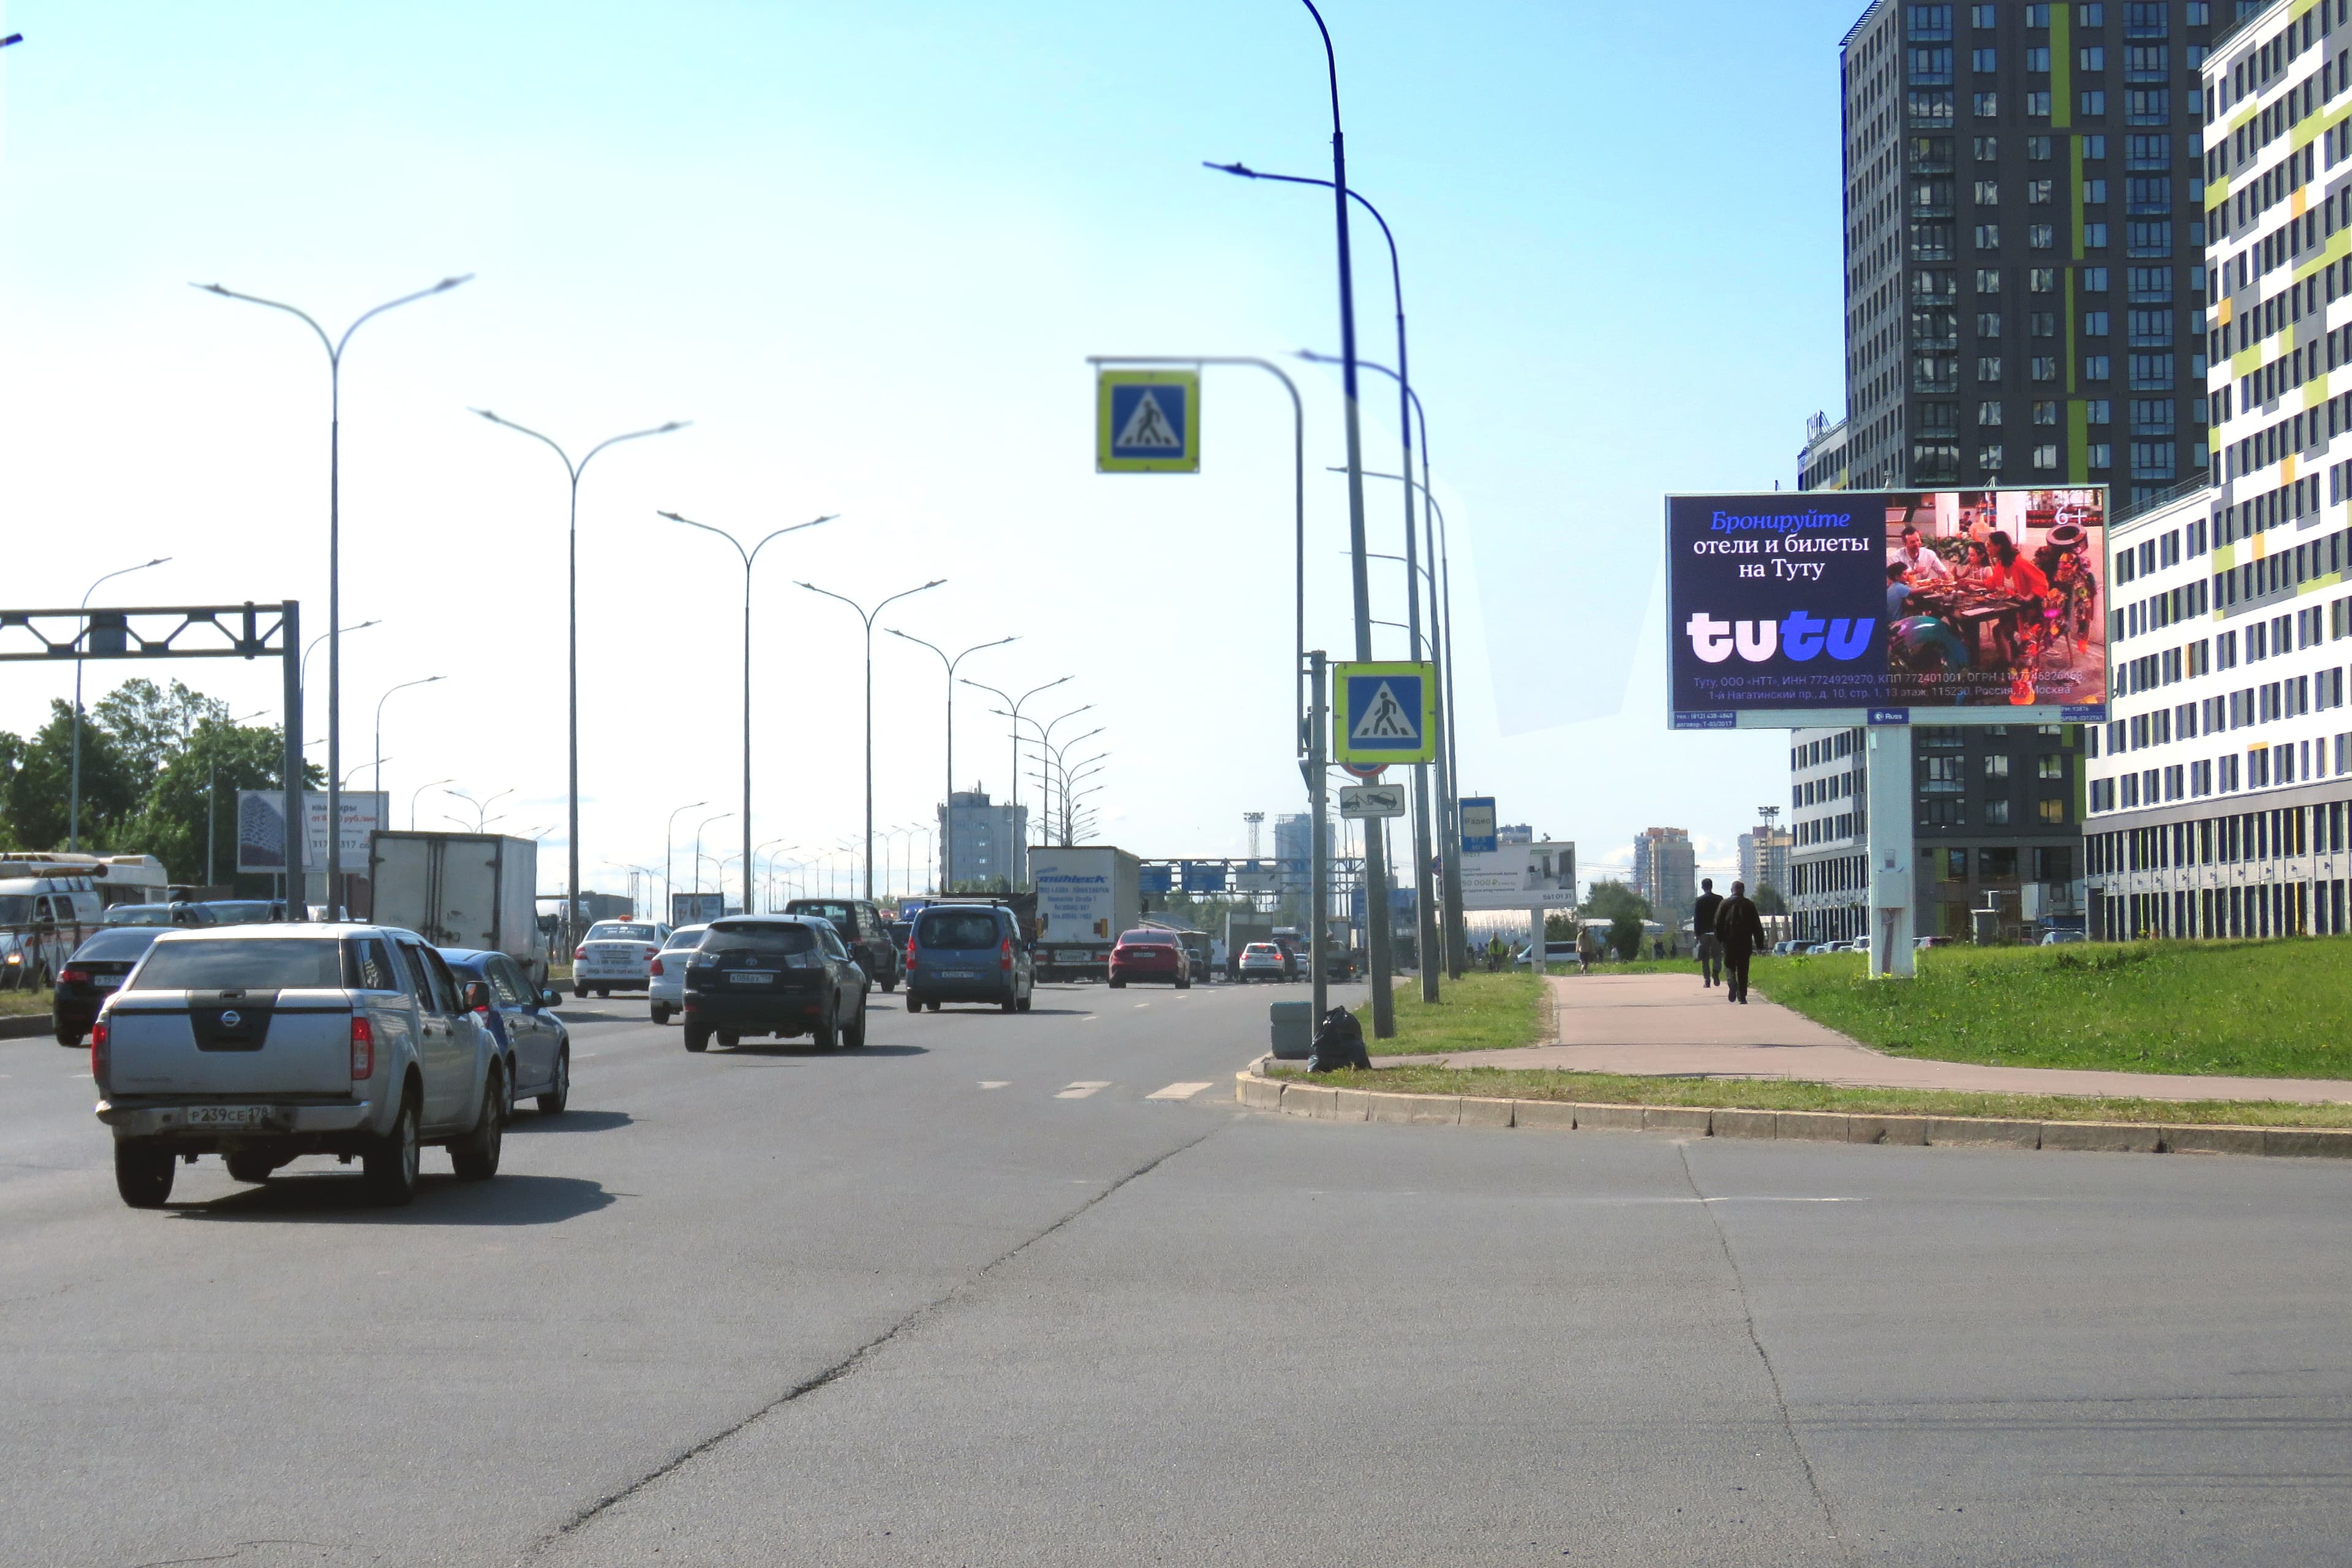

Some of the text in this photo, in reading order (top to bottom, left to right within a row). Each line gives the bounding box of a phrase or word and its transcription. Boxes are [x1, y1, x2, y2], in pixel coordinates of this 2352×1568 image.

[1711, 509, 1850, 534] Бронируйте
[2054, 507, 2087, 524] 6+
[1694, 533, 1869, 554] отели и билеты
[1739, 558, 1825, 581] на Туту
[1686, 611, 1875, 663] tutu
[1694, 677, 1716, 688] Туту,
[1721, 677, 1744, 686] ООО
[1783, 676, 1806, 685] ИНН
[1879, 674, 1901, 684] КПП
[1967, 672, 1996, 682] ОГРН
[1709, 690, 1724, 700] 1-й
[1728, 690, 1796, 699] Нагатинский
[1886, 688, 1898, 696] 13
